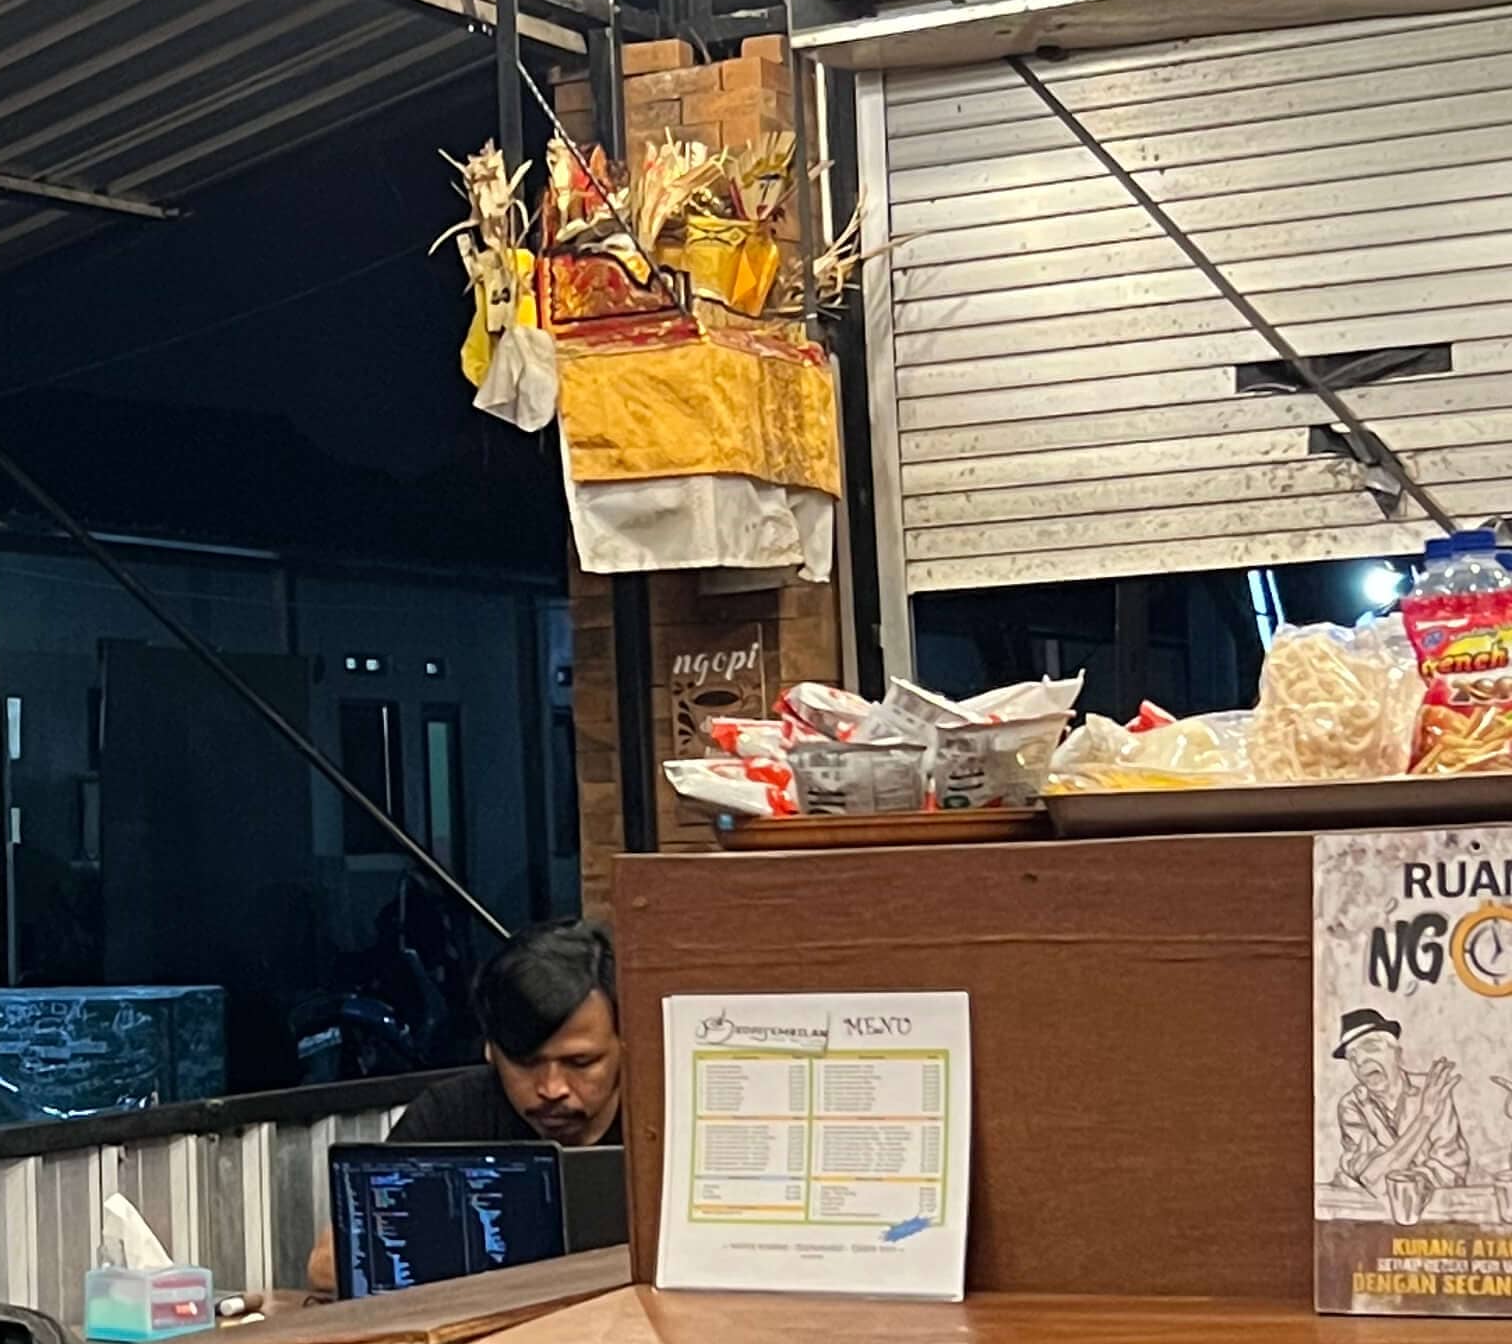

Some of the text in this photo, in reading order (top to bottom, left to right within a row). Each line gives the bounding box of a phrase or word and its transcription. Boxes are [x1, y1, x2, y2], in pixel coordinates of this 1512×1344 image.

[673, 642, 760, 687] ngopi
[1404, 859, 1512, 899] RUA
[843, 1016, 912, 1037] MENU
[1392, 1238, 1512, 1258] KURANG ATA
[1352, 1272, 1436, 1295] DENGAN
